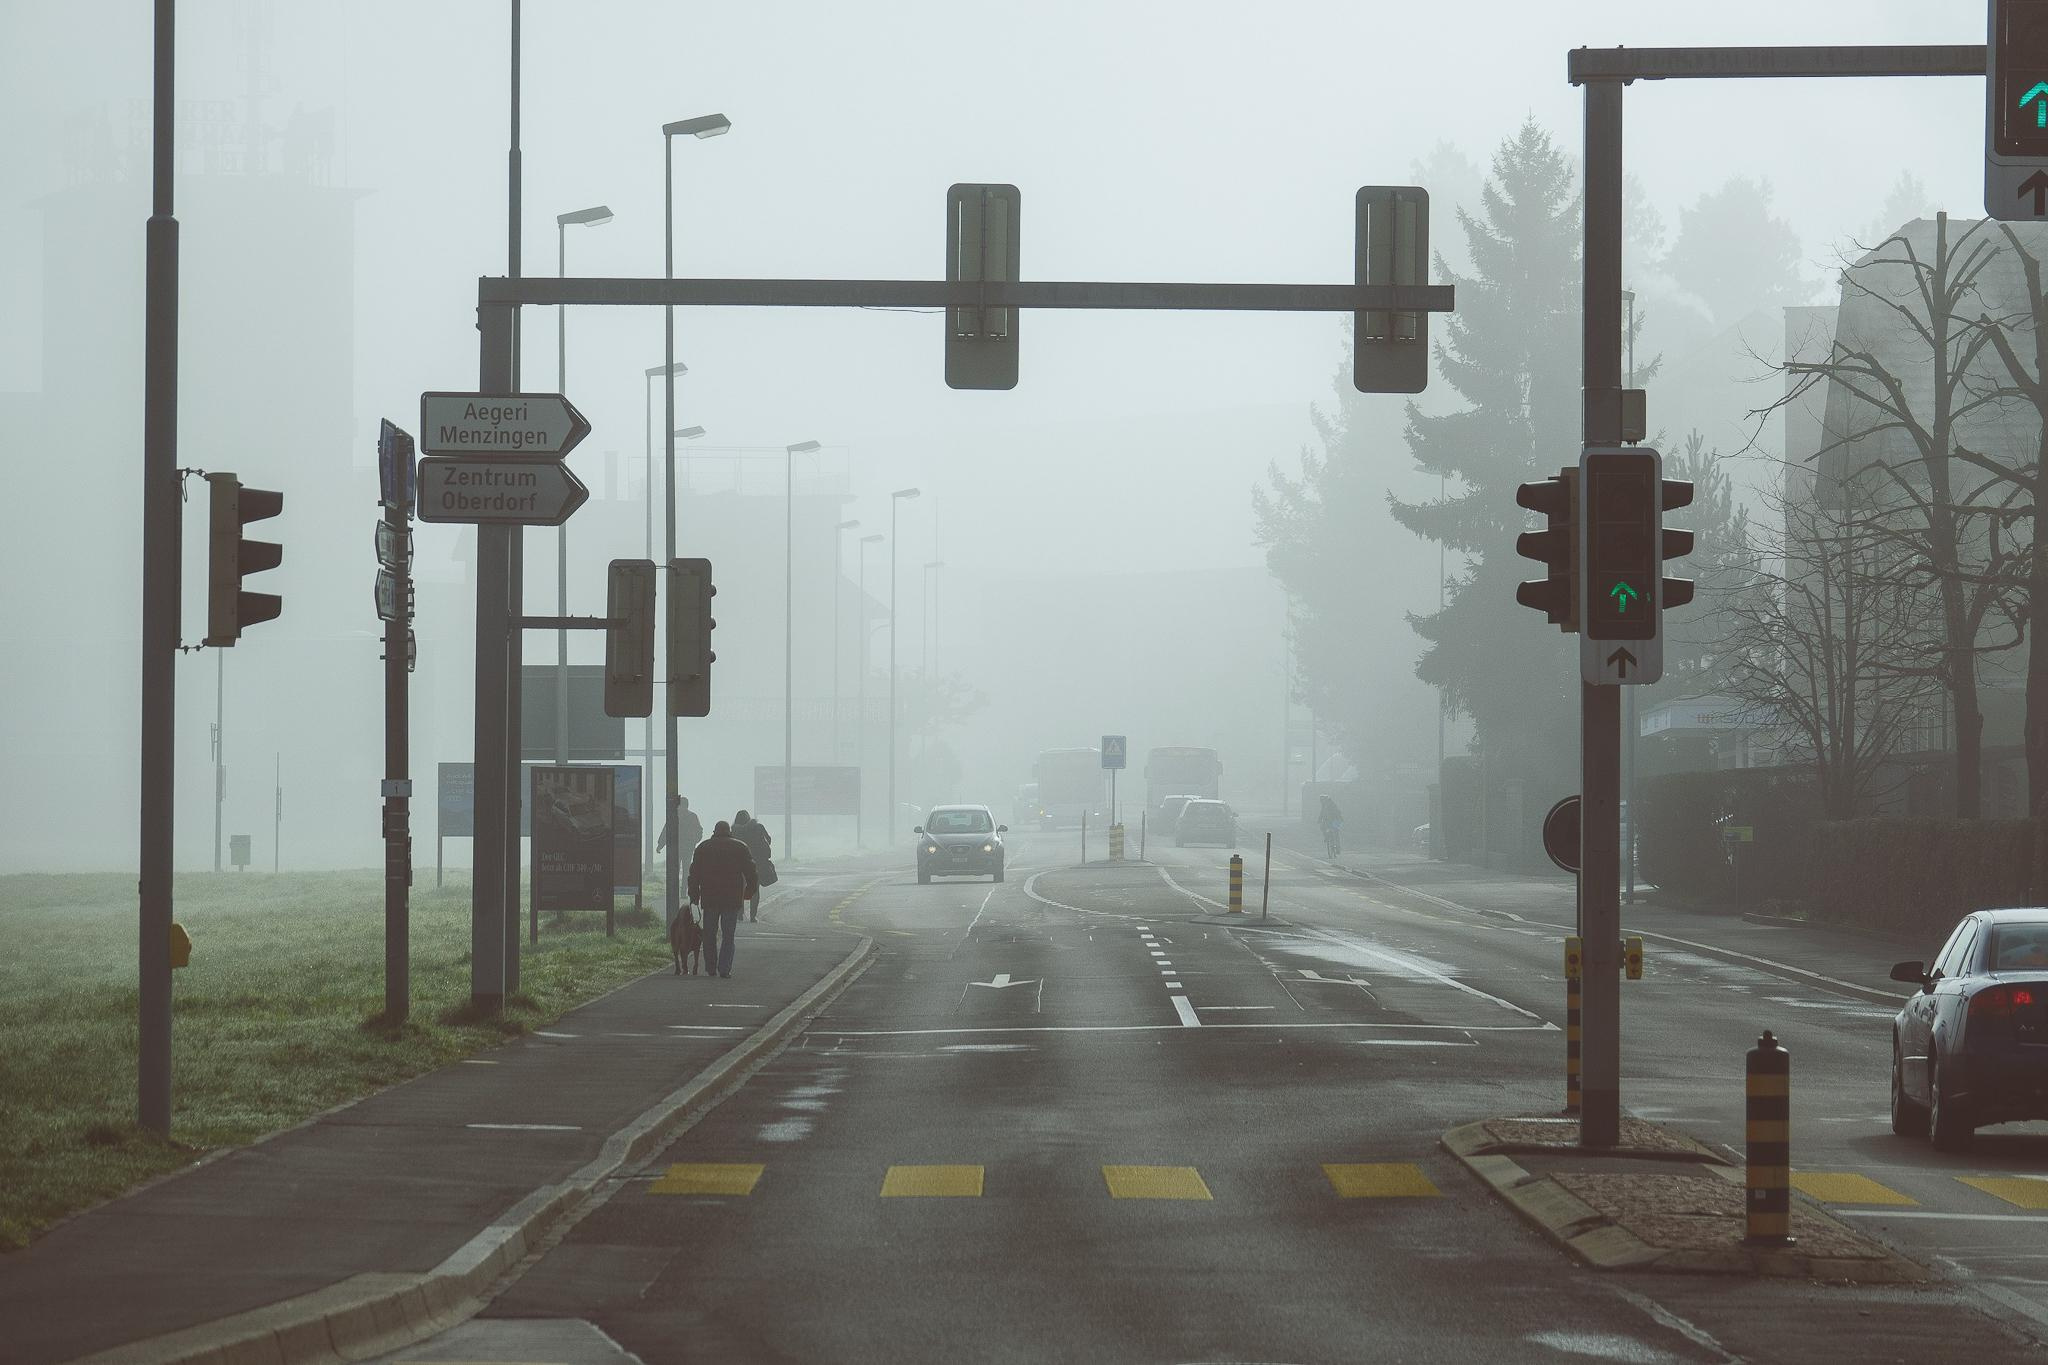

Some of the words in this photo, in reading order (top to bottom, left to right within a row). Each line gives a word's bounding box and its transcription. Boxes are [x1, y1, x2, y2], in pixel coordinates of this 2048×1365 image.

[463, 402, 528, 426] Aegeri
[440, 426, 547, 449] Menzingen
[443, 467, 537, 486] Zentrum
[442, 491, 538, 511] Oberdorf
